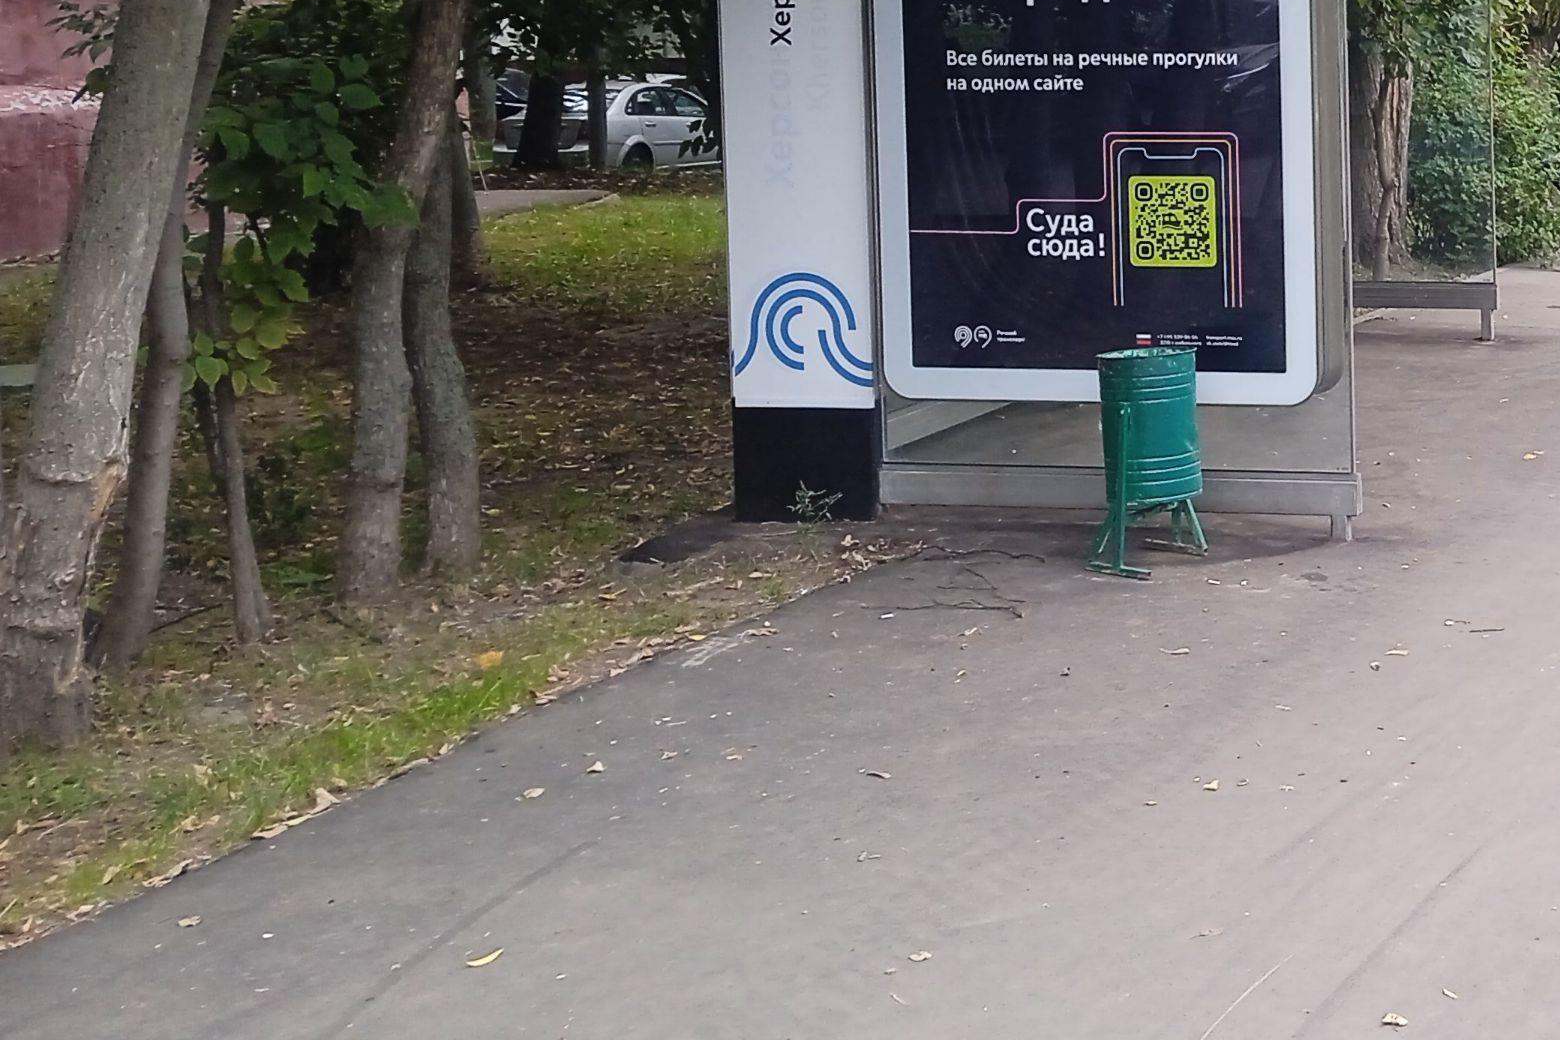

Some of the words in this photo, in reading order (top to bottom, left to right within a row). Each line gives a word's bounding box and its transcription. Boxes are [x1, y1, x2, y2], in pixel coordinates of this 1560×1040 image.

[945, 50, 977, 68] Все
[981, 50, 1048, 67] билеты
[1052, 53, 1075, 66] на
[1078, 52, 1148, 69] речные
[1152, 51, 1239, 70] прогулки
[946, 78, 967, 91] на
[971, 78, 1030, 93] одном
[1033, 75, 1085, 91] сайте
[1026, 208, 1094, 239] Суда
[1026, 232, 1106, 260] сюда!
